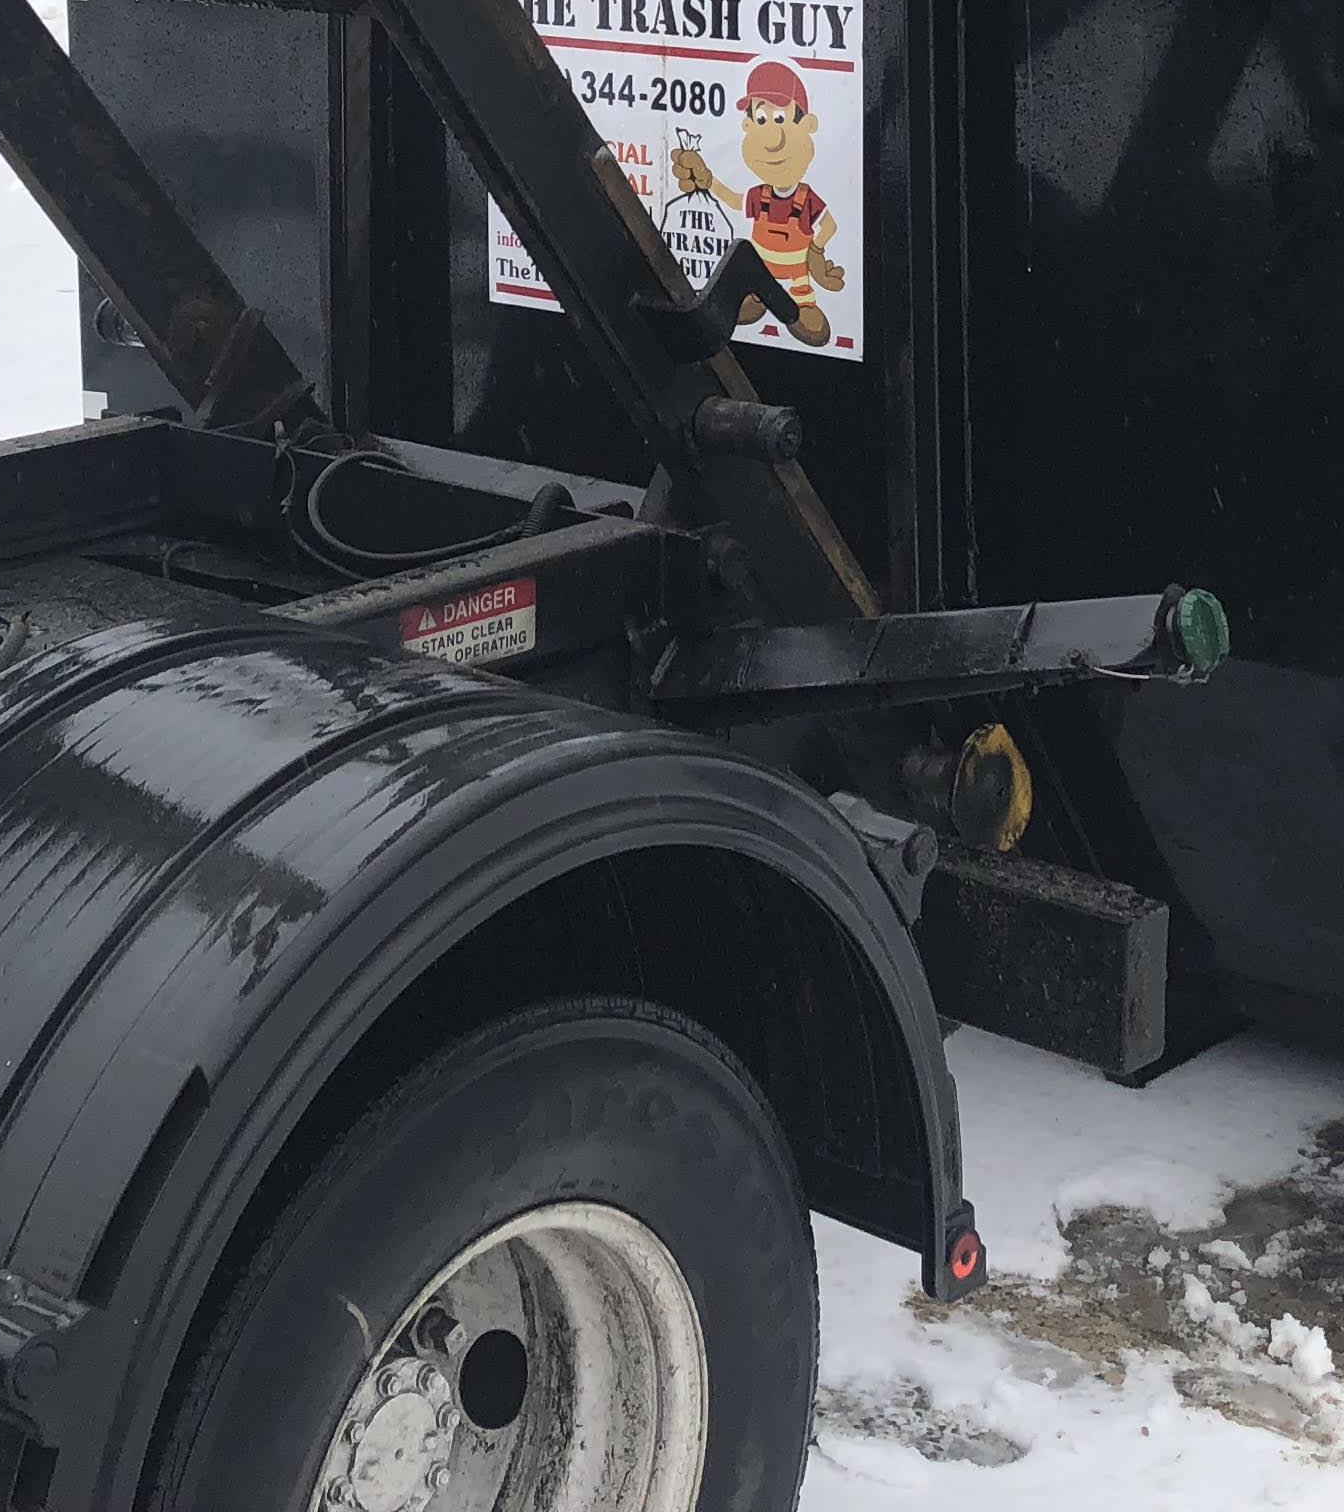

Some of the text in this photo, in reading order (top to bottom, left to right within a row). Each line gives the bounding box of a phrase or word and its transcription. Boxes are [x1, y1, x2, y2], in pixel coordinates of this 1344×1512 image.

[757, 0, 854, 50] GUY
[581, 70, 726, 117] 344-2080
[680, 210, 716, 232] THE
[662, 232, 729, 257] TRASH
[679, 257, 716, 279] GUY
[444, 587, 515, 624] DANGER
[421, 617, 513, 655] STAND CLEAR
[455, 630, 527, 662] OPERATING
